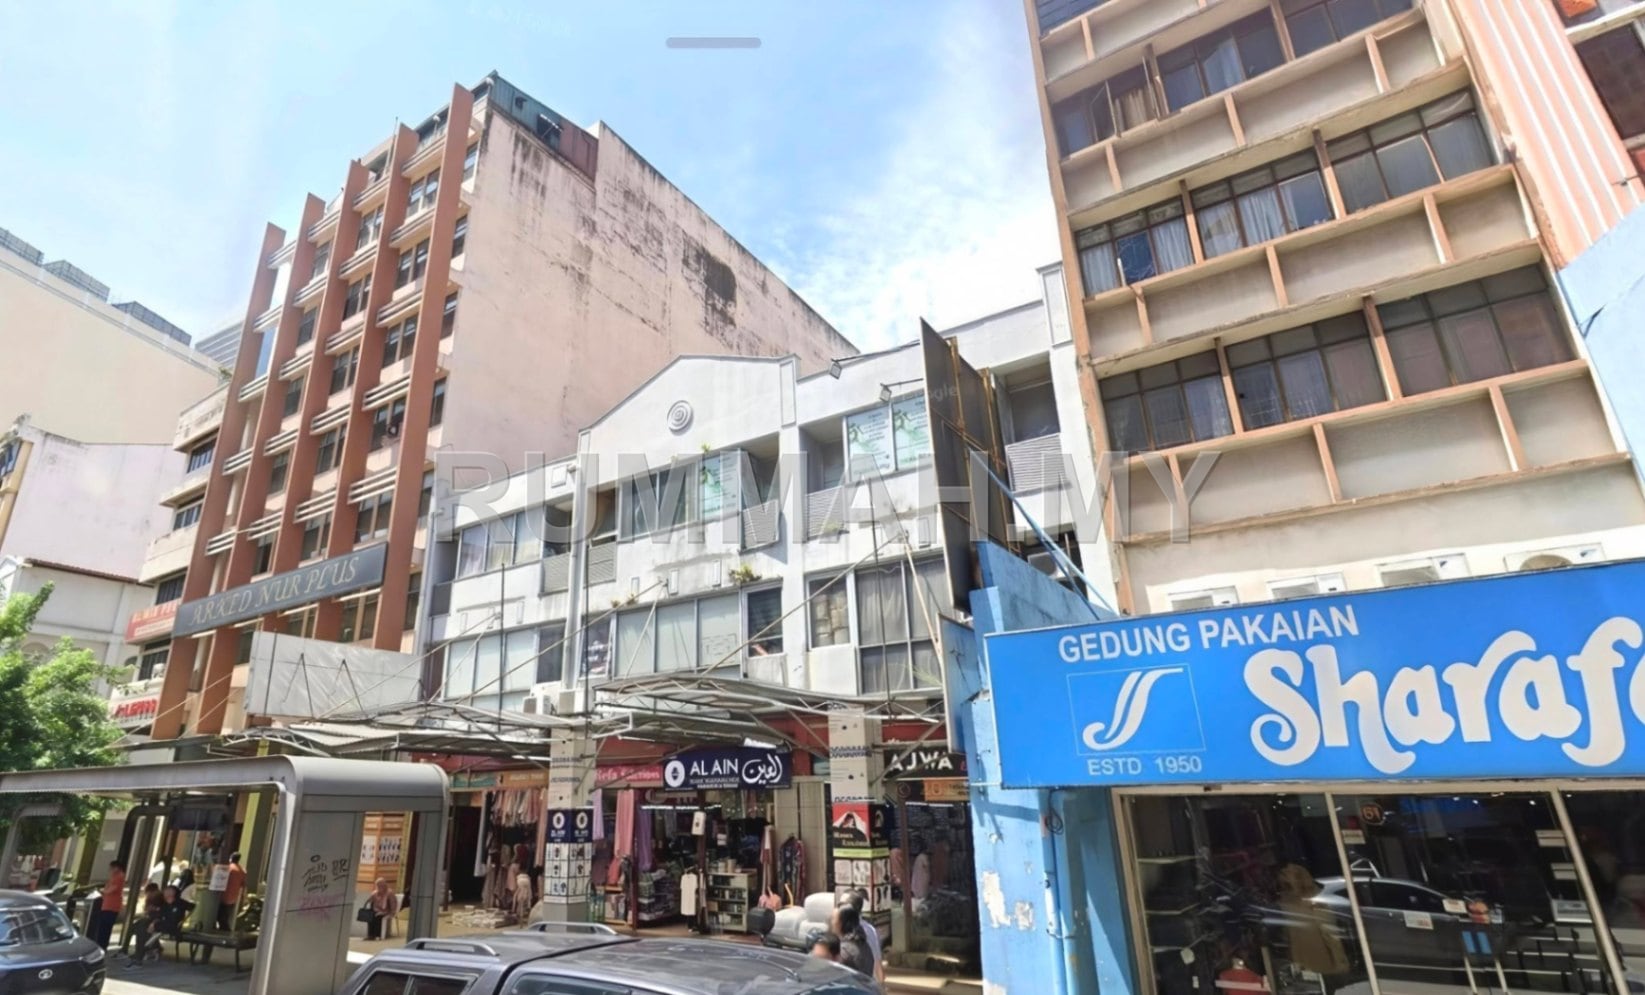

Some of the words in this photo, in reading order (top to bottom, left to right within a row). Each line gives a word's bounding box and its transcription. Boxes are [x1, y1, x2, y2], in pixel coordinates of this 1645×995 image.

[255, 574, 302, 608] NUR
[304, 556, 360, 594] PLUS
[1058, 622, 1191, 663] GEDUNG
[1198, 604, 1359, 649] PAKAIAN
[1243, 616, 1645, 774] Sharaf
[689, 759, 709, 776] AL
[711, 758, 739, 775] AIN
[889, 750, 954, 772] AJWA
[1087, 757, 1143, 776] ESTD
[1155, 755, 1202, 774] 1950
